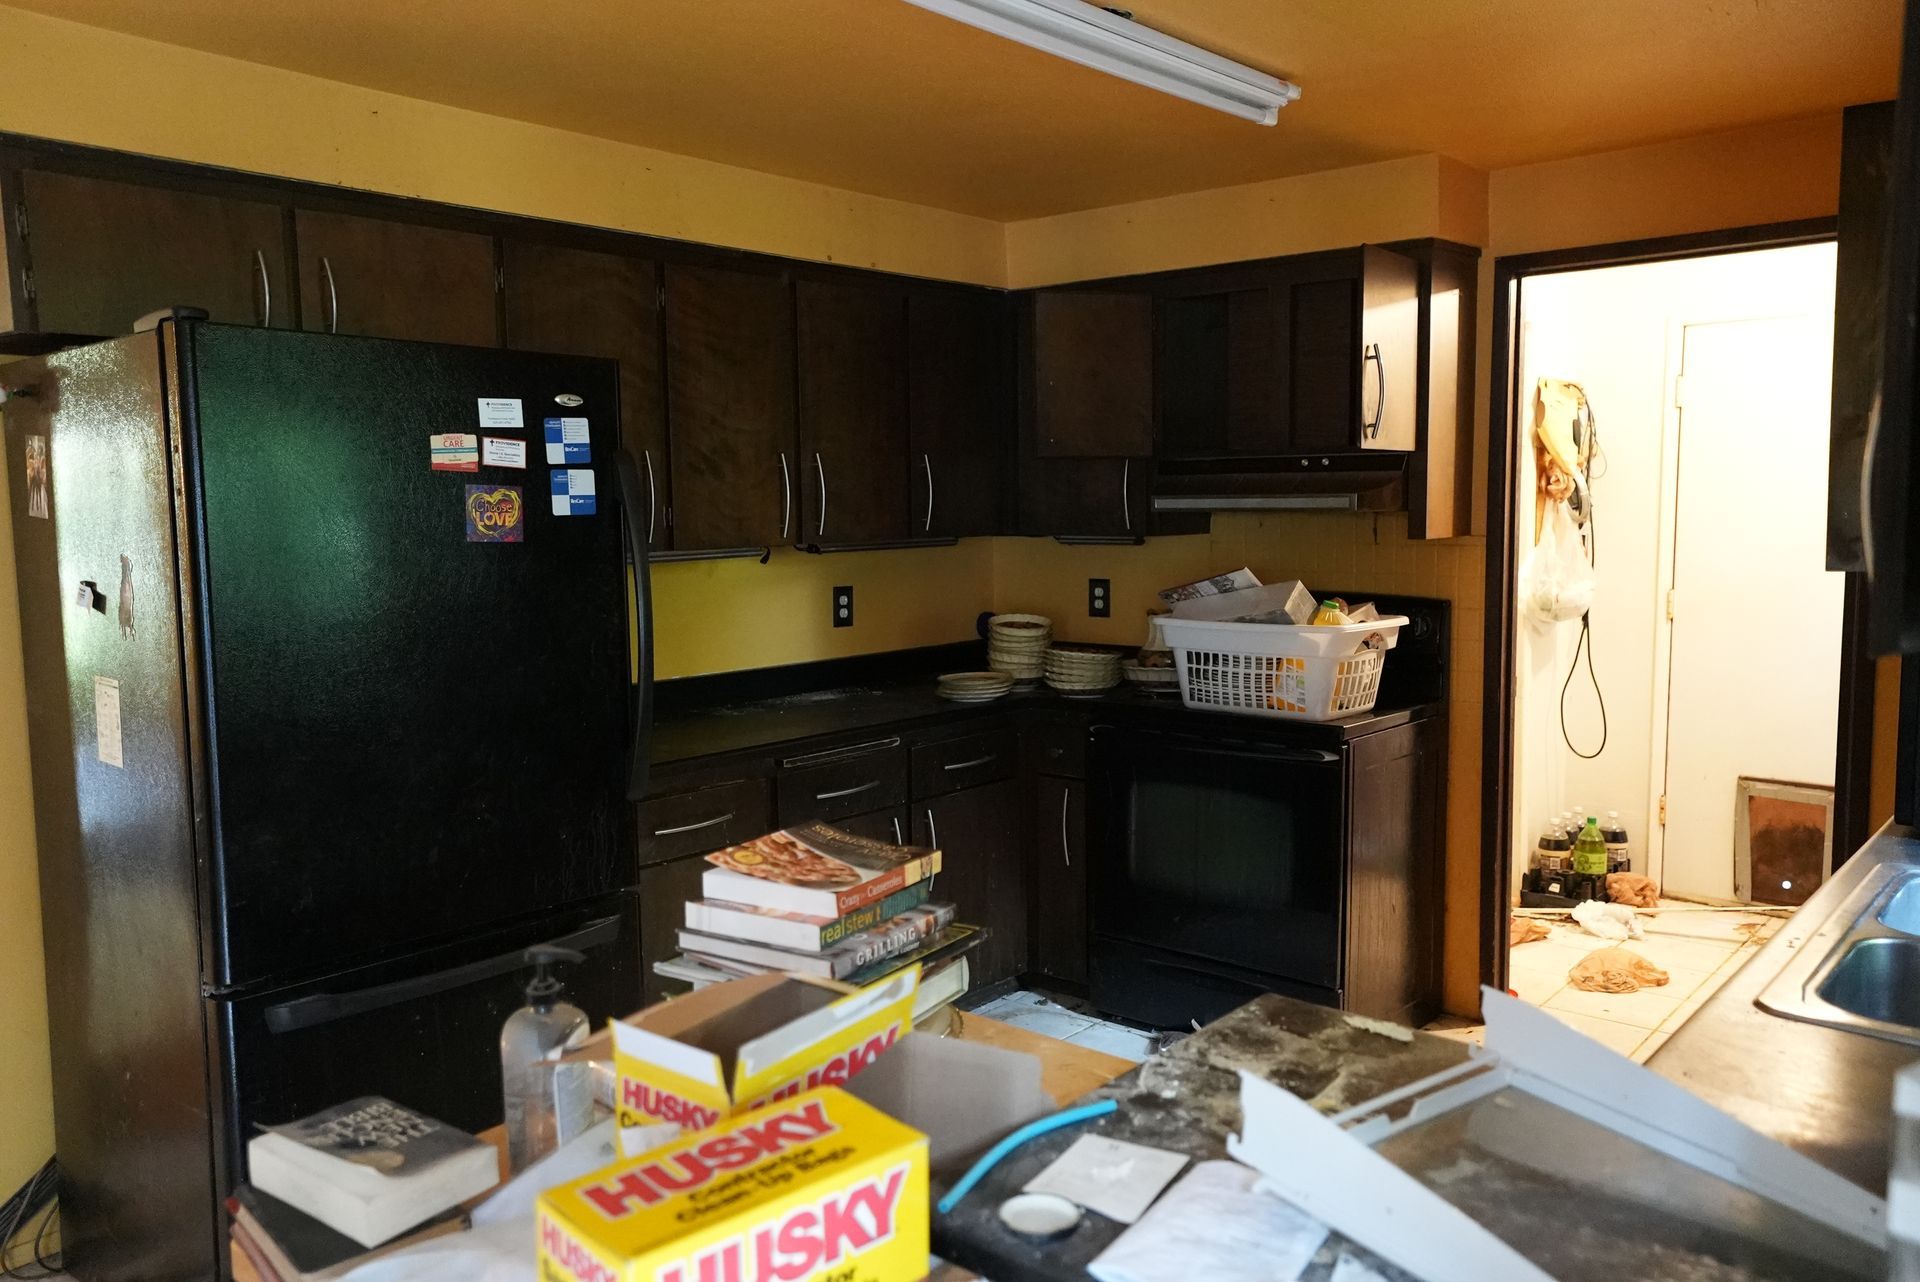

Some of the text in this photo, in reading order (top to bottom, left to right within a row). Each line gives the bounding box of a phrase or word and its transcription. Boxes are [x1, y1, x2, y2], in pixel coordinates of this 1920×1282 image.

[443, 440, 465, 448] CARE
[475, 511, 515, 528] LOVE
[476, 498, 513, 512] Choose
[821, 911, 874, 946] real stew
[856, 927, 917, 966] GRILLING
[622, 1076, 720, 1132] HUSKY
[582, 1101, 836, 1219] HUSKY
